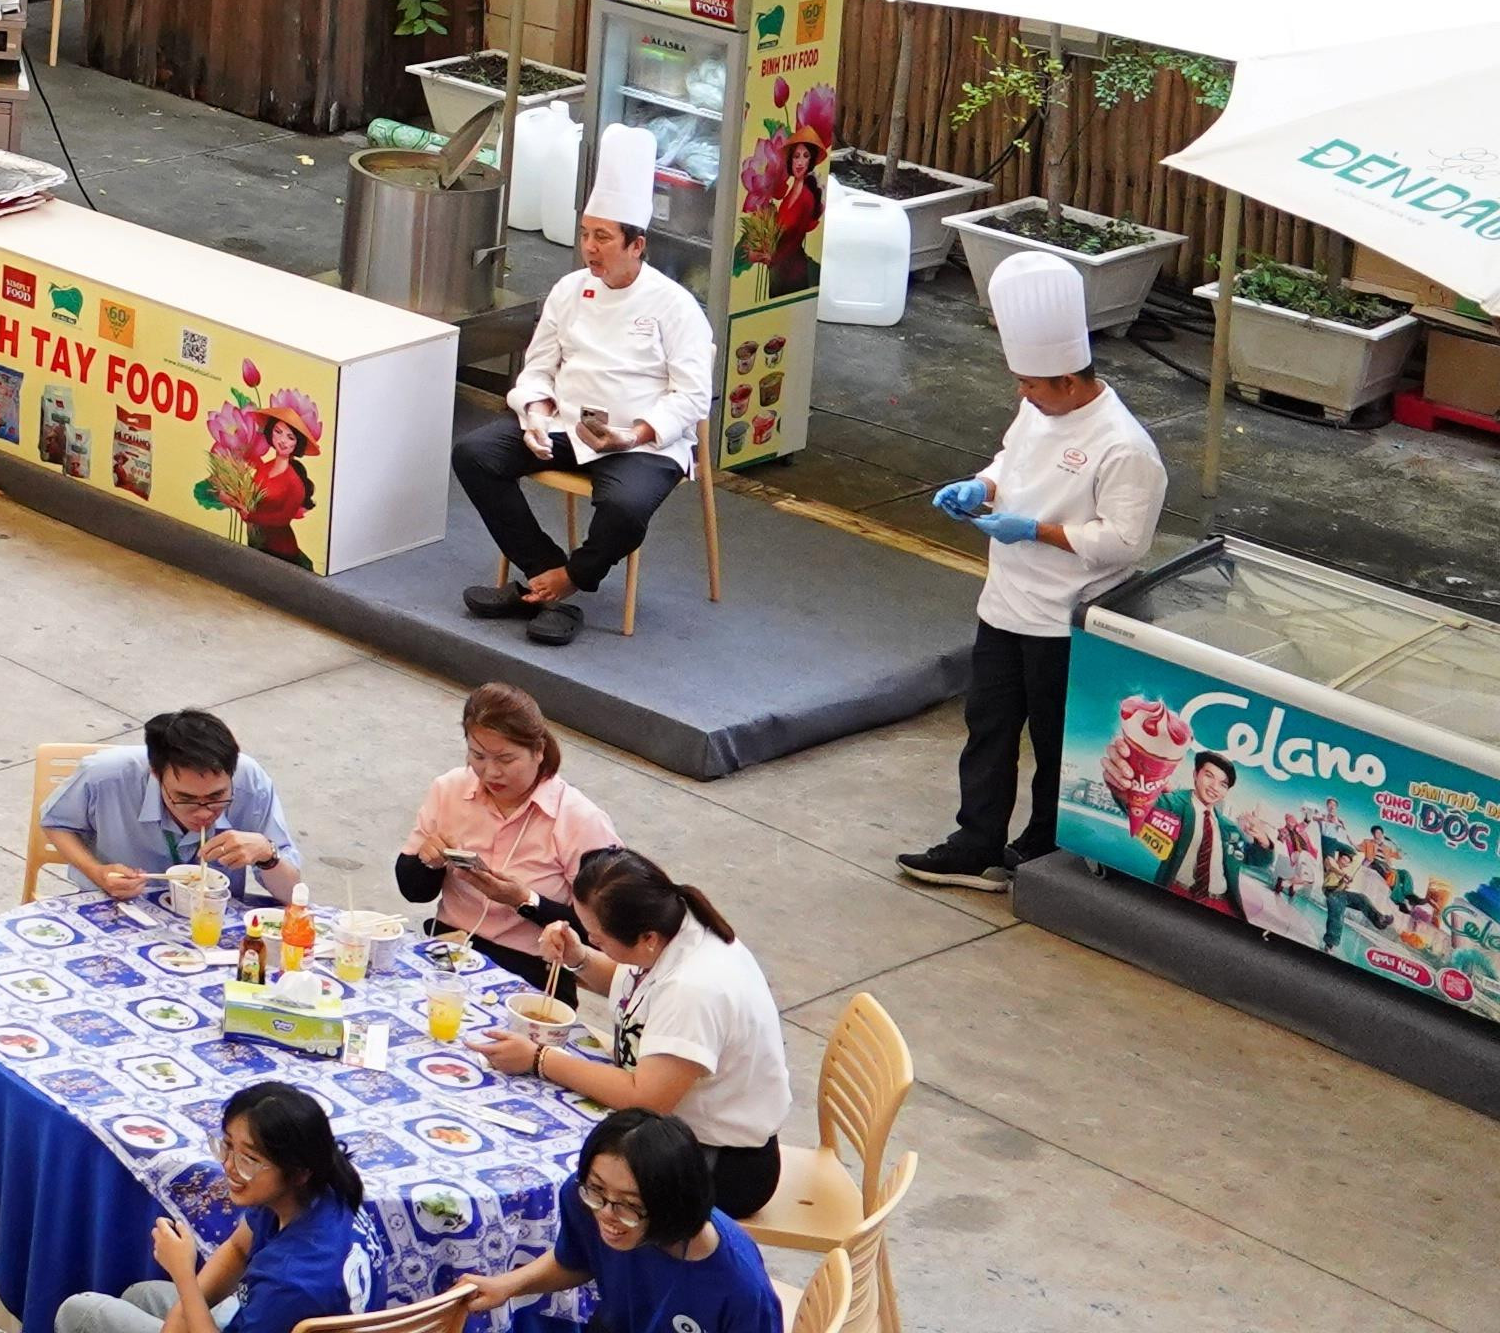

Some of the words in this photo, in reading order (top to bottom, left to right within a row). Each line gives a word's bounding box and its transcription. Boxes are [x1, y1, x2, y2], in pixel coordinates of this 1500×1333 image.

[695, 2, 729, 19] FOOD
[761, 55, 780, 78] BINH
[782, 53, 797, 71] TAY
[799, 48, 819, 70] FOOD
[5, 286, 32, 304] FOOD
[108, 306, 126, 323] 60
[30, 326, 98, 385] TAY
[105, 356, 200, 423] FOOD
[1179, 690, 1387, 789] Celano
